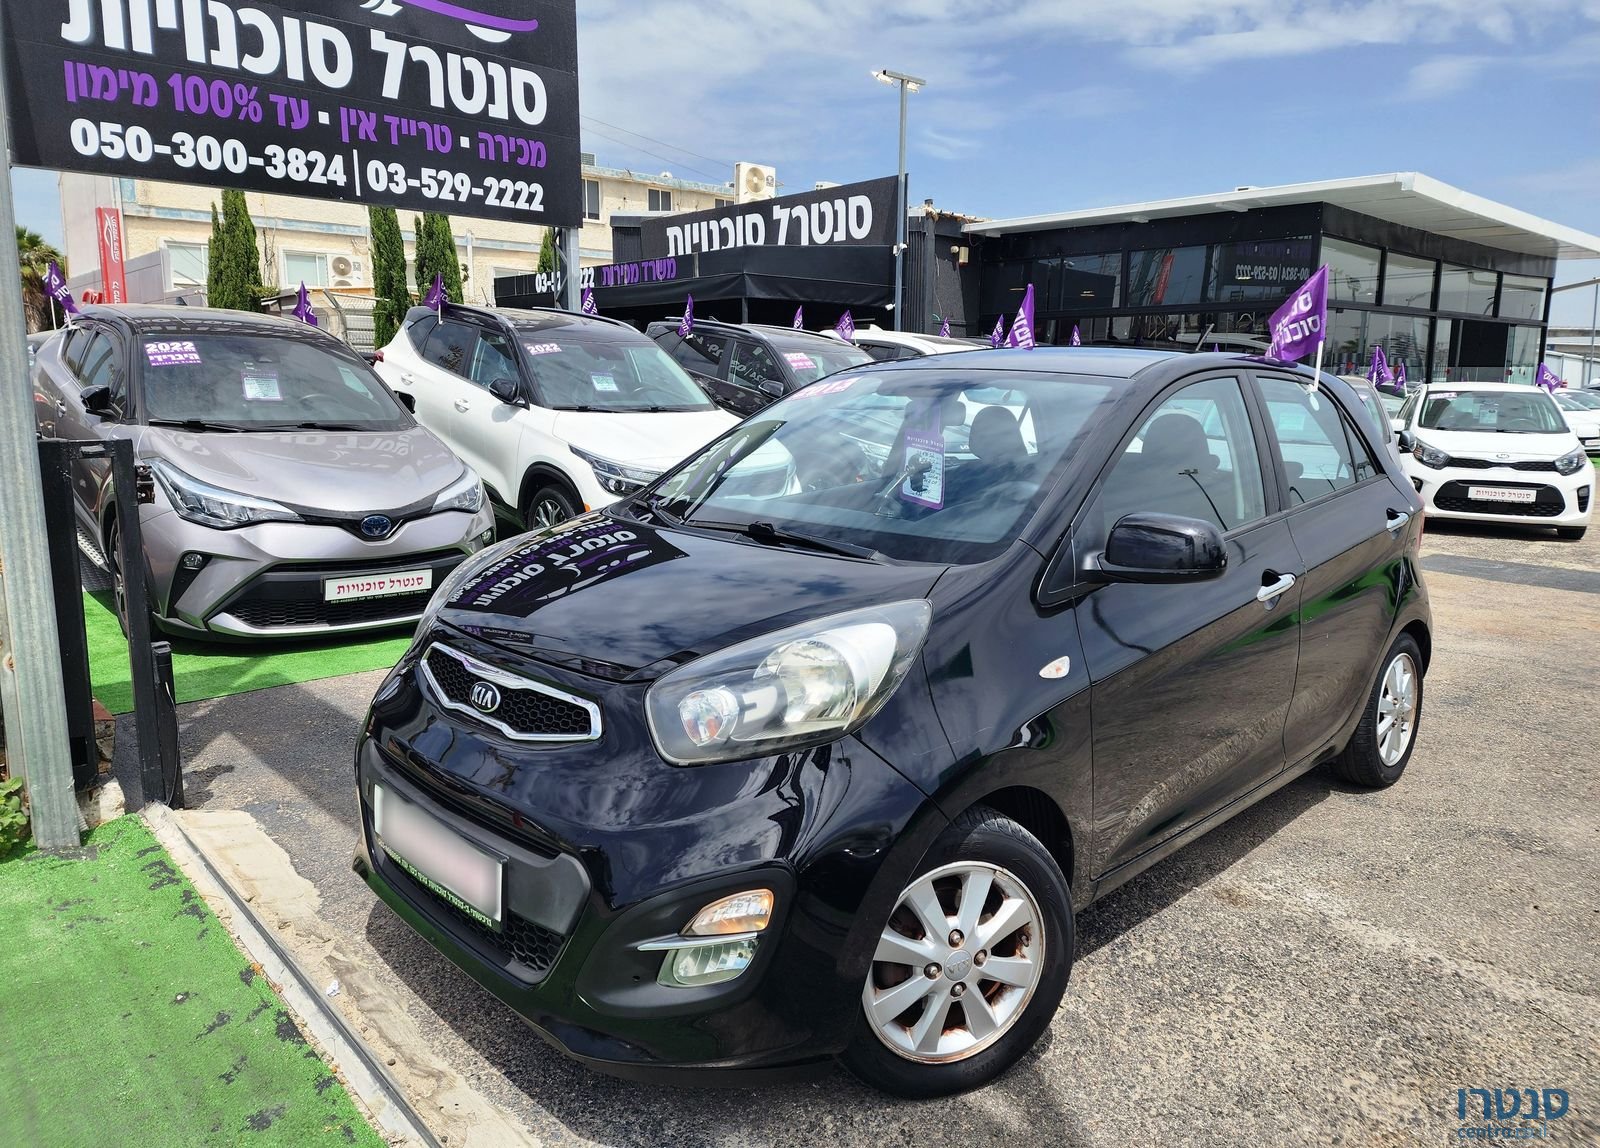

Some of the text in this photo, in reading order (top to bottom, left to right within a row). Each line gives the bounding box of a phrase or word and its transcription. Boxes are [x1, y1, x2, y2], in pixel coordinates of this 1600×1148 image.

[370, 28, 548, 126] סנטרל
[63, 60, 547, 168] מכירה טרייד אין עד 100% מימון
[70, 117, 545, 212] 050-300-3824 03-529-2222
[666, 194, 873, 258] סנטרל סוכנויות
[601, 257, 677, 287] משרד מכירות
[145, 341, 195, 352] 2022
[527, 343, 561, 354] 2022
[1475, 490, 1506, 498] סוכנויות
[337, 576, 424, 595] סנטרל סוכנויות
[471, 684, 494, 708] KIA
